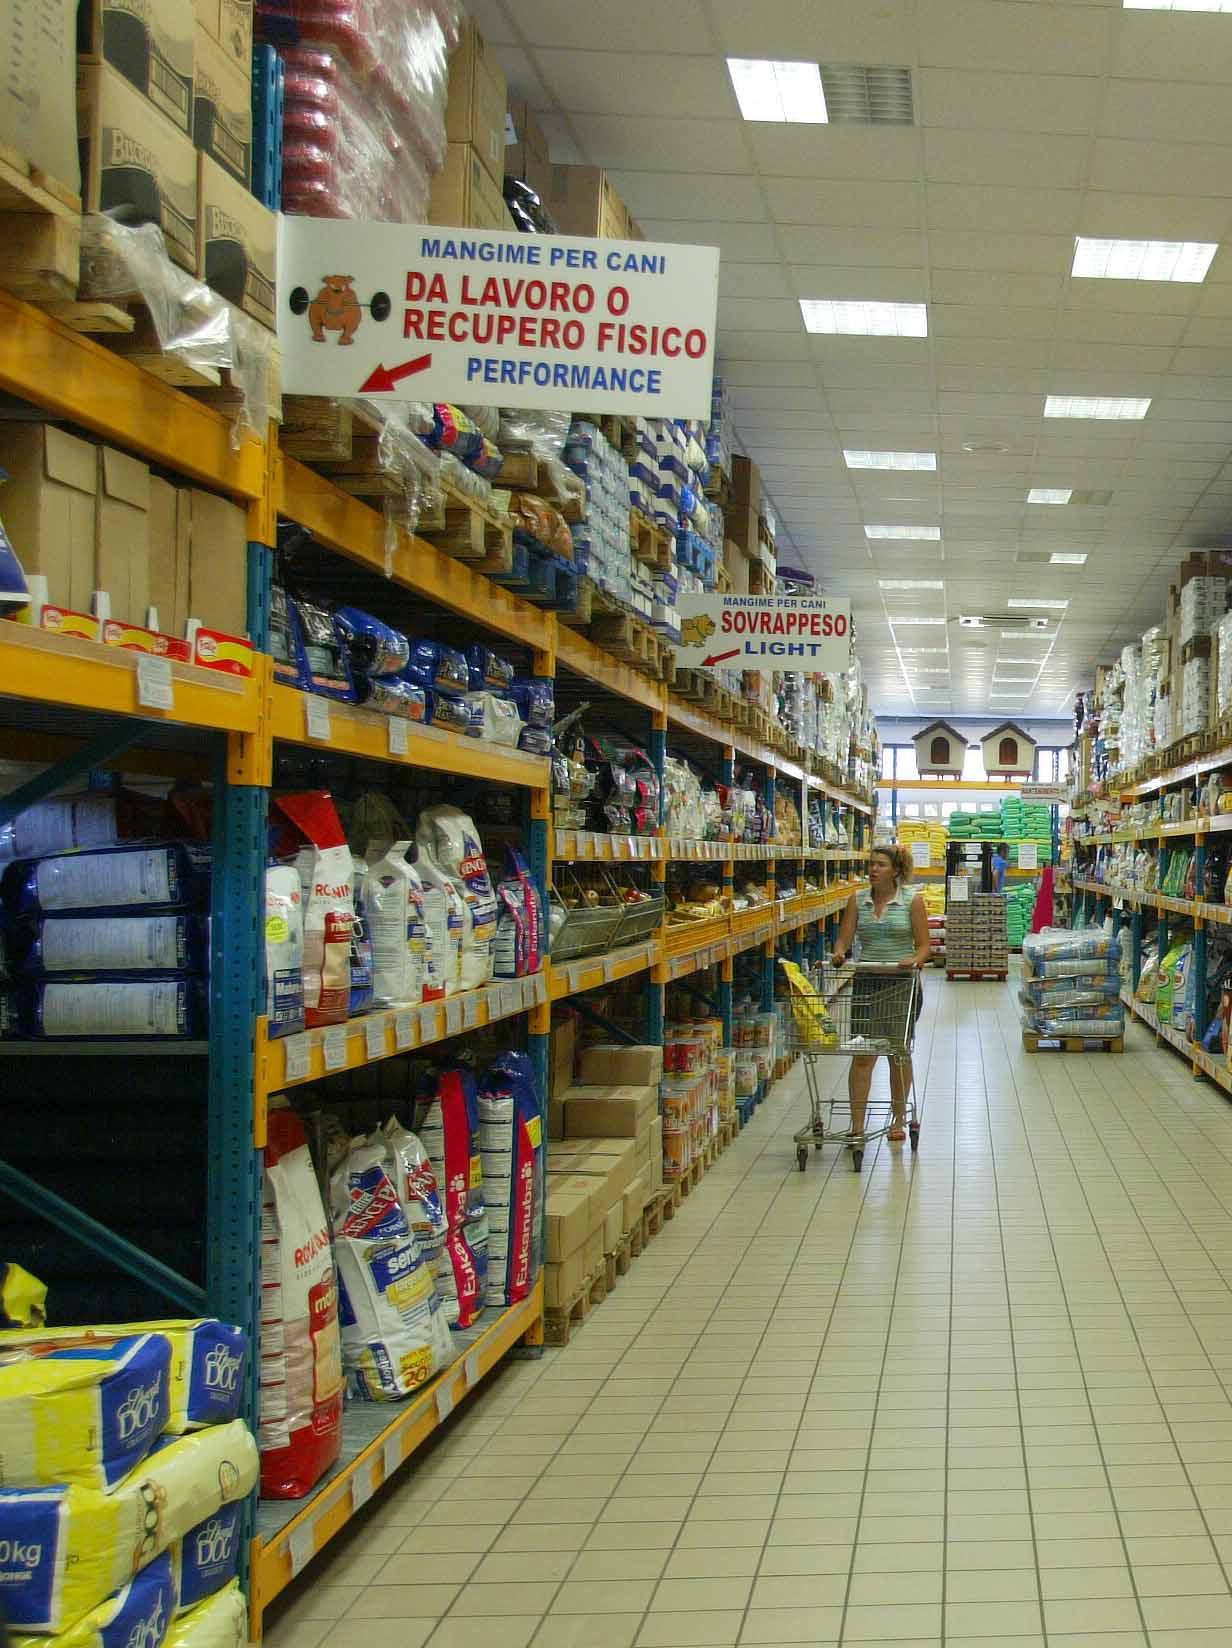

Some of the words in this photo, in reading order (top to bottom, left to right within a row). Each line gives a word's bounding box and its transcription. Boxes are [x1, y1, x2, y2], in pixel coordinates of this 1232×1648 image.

[421, 238, 541, 265] MANGIME
[550, 248, 597, 269] PER
[606, 252, 666, 274] CANI
[405, 271, 448, 303] DA
[460, 275, 595, 314] LAVORO
[607, 286, 630, 316] O
[403, 308, 585, 350] RECUPERO
[597, 322, 707, 359] FISICO
[466, 357, 662, 394] PERFORMANCE
[723, 597, 774, 607] MANGIME
[777, 598, 797, 608] PER
[801, 599, 826, 609] CANI
[721, 610, 847, 637] SOVRAPPESO
[745, 641, 822, 656] LIGHT
[516, 1179, 533, 1287] Eukanuba
